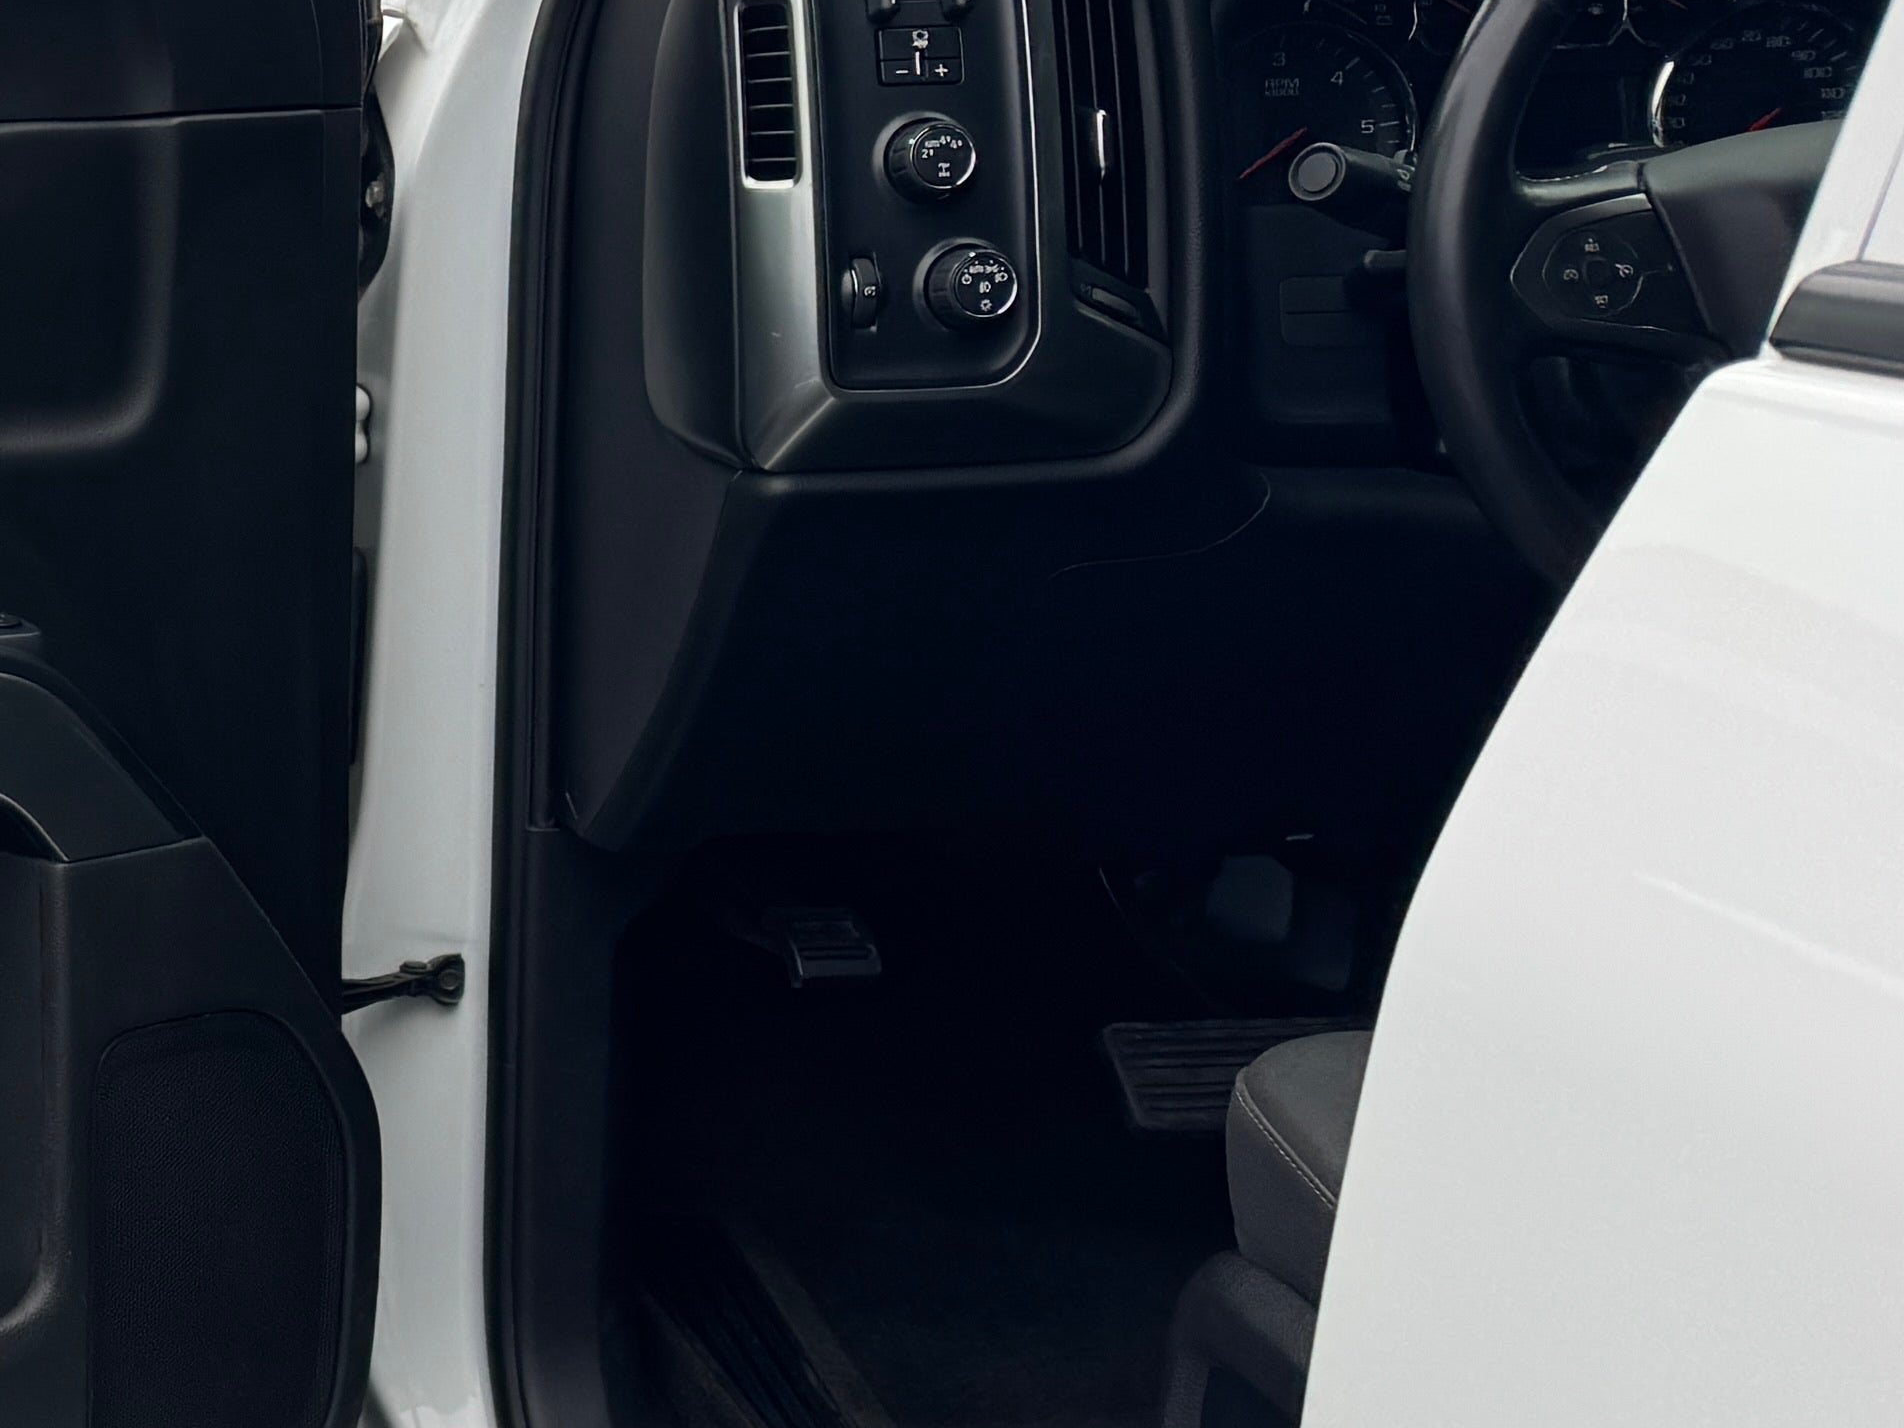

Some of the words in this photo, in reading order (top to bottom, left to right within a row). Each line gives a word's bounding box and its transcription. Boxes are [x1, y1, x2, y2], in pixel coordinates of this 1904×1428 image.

[1272, 51, 1286, 68] 3
[1329, 70, 1345, 86] 4
[1360, 119, 1376, 134] 5
